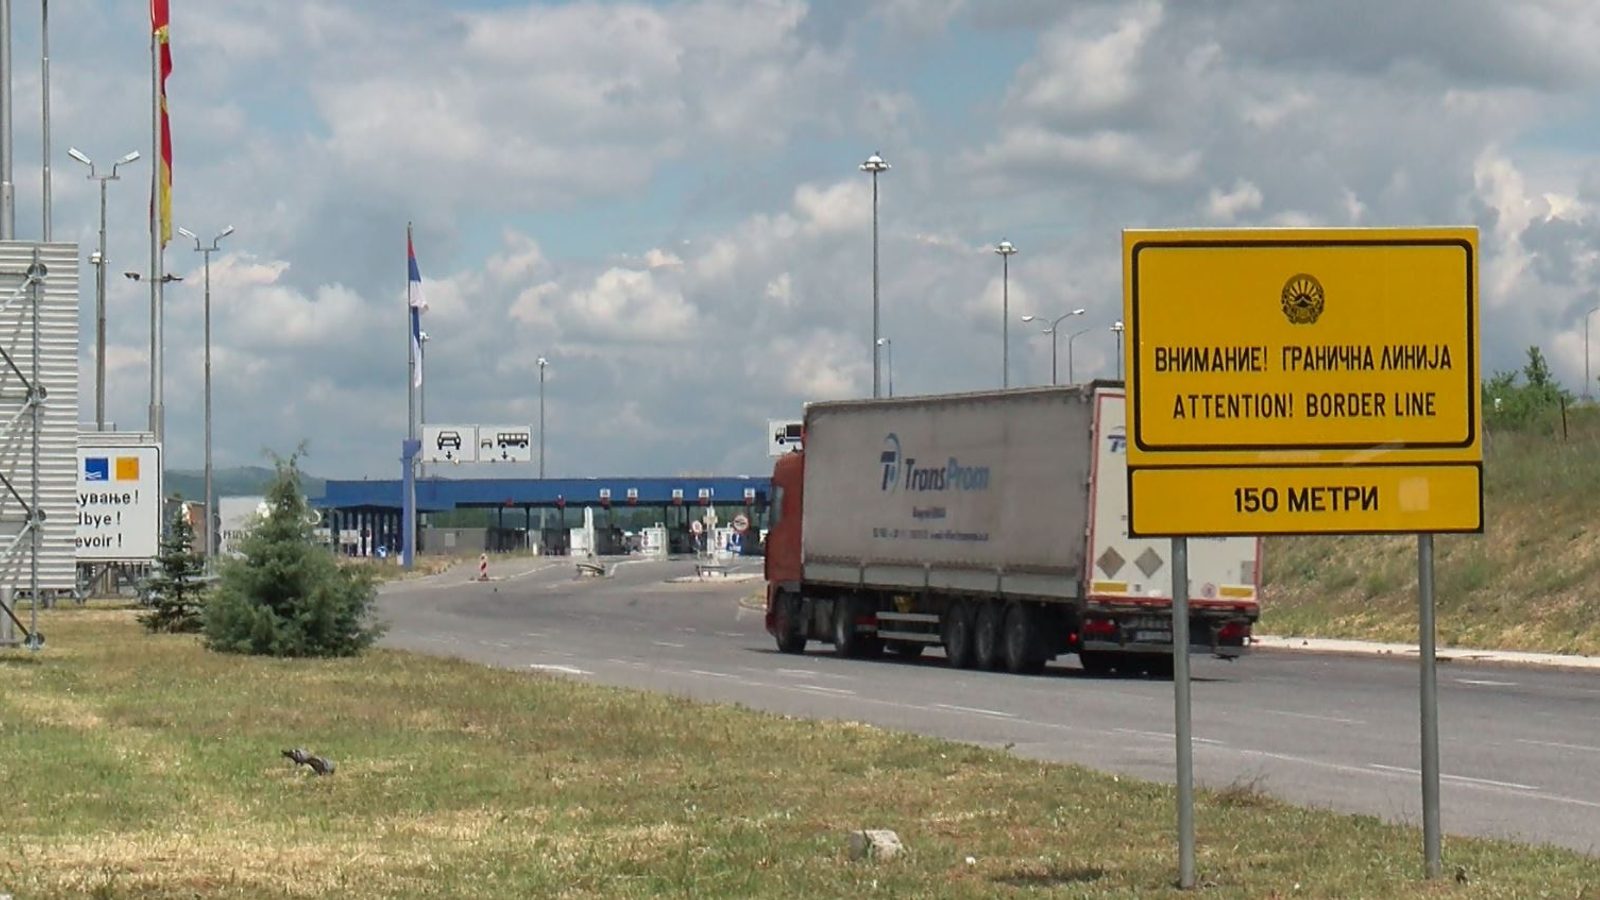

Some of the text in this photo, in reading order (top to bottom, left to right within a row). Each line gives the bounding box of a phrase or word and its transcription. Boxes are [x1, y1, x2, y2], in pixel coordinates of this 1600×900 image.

[1155, 344, 1452, 373] ВНИМАНИЕ! ГРАНИЧНА ЛИНИЈА
[1173, 391, 1436, 419] ATTENTION! BORDER LINE
[1234, 485, 1378, 513] 150 МЕТРИ
